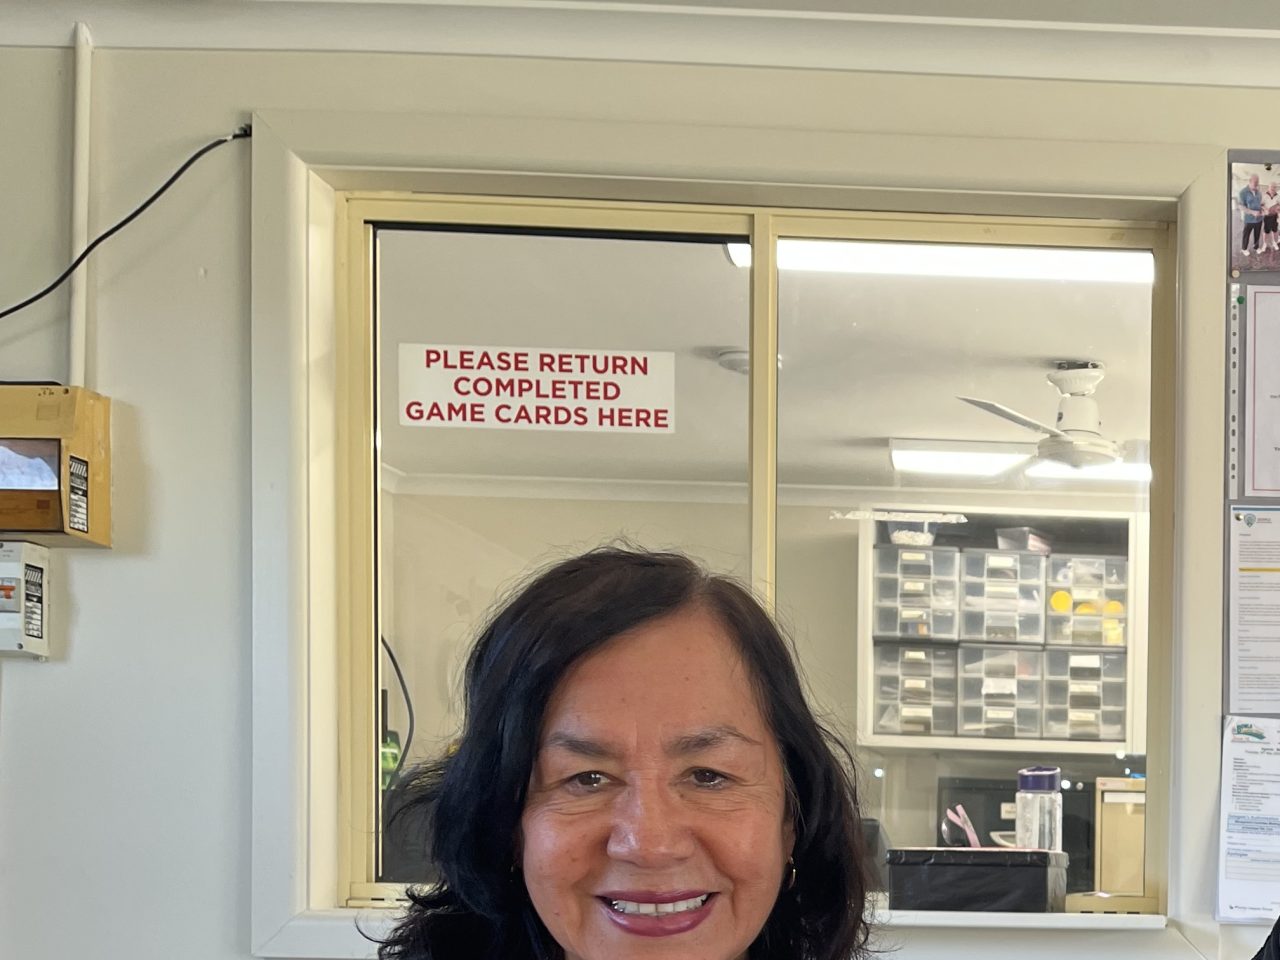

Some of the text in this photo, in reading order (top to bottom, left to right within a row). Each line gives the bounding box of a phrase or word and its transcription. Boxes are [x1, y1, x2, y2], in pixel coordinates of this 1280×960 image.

[425, 349, 649, 376] PLEASE RETURN
[453, 376, 621, 401] COMPLETED
[405, 401, 669, 428] GAME CARDS HERE
